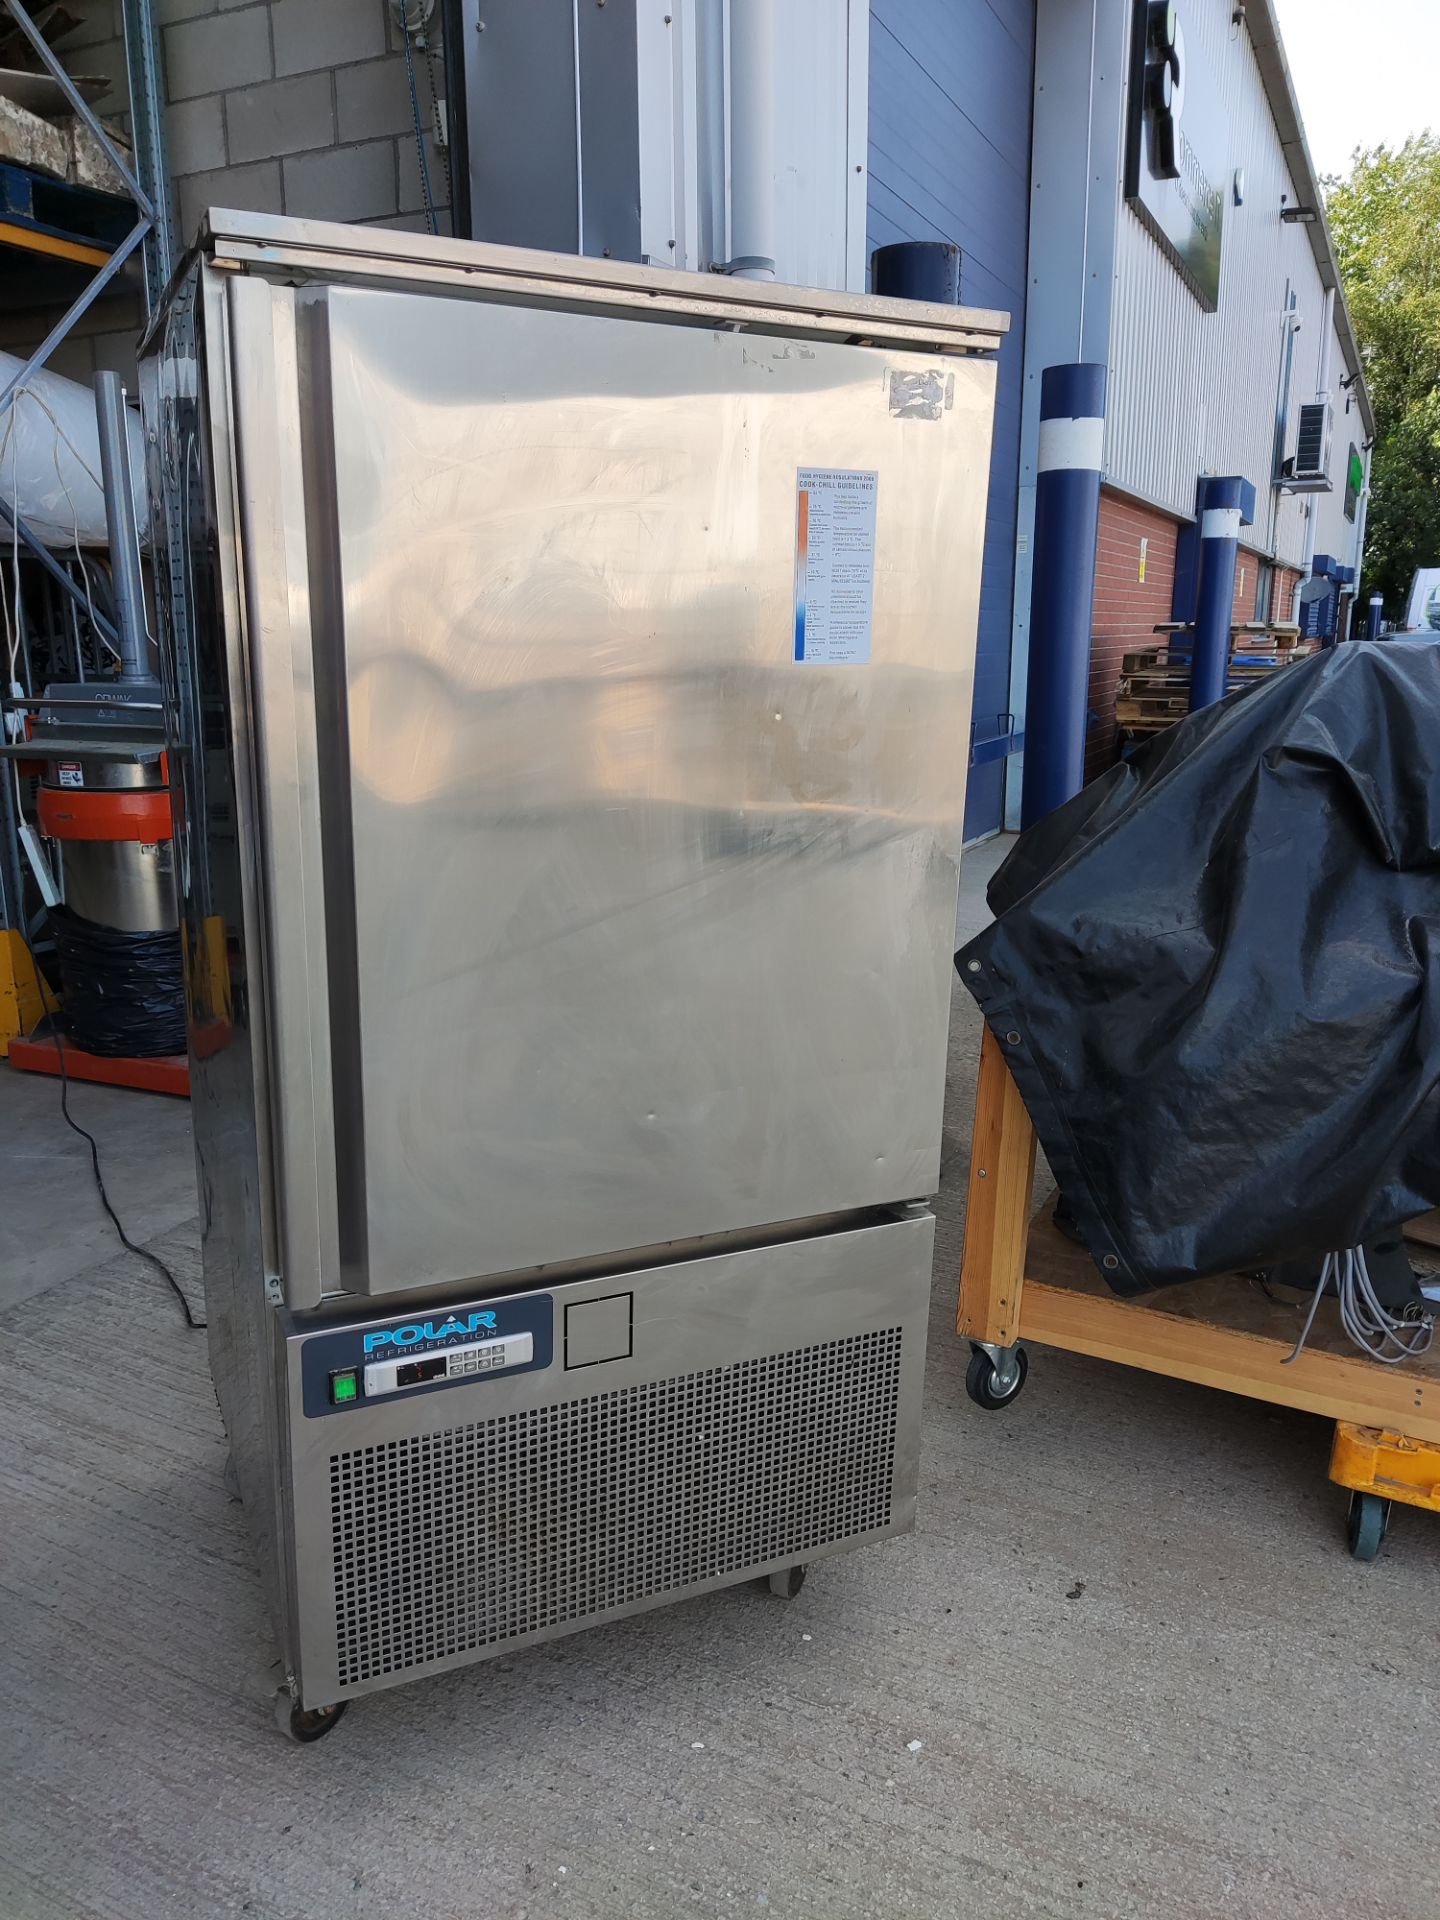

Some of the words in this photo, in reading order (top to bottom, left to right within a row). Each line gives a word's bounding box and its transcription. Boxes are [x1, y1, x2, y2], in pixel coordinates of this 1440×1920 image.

[799, 480, 836, 489] COOK-CHILL
[837, 482, 873, 490] GUIDELINES
[363, 1311, 498, 1353] POLAR
[364, 1329, 497, 1361] REFRIGERATION
